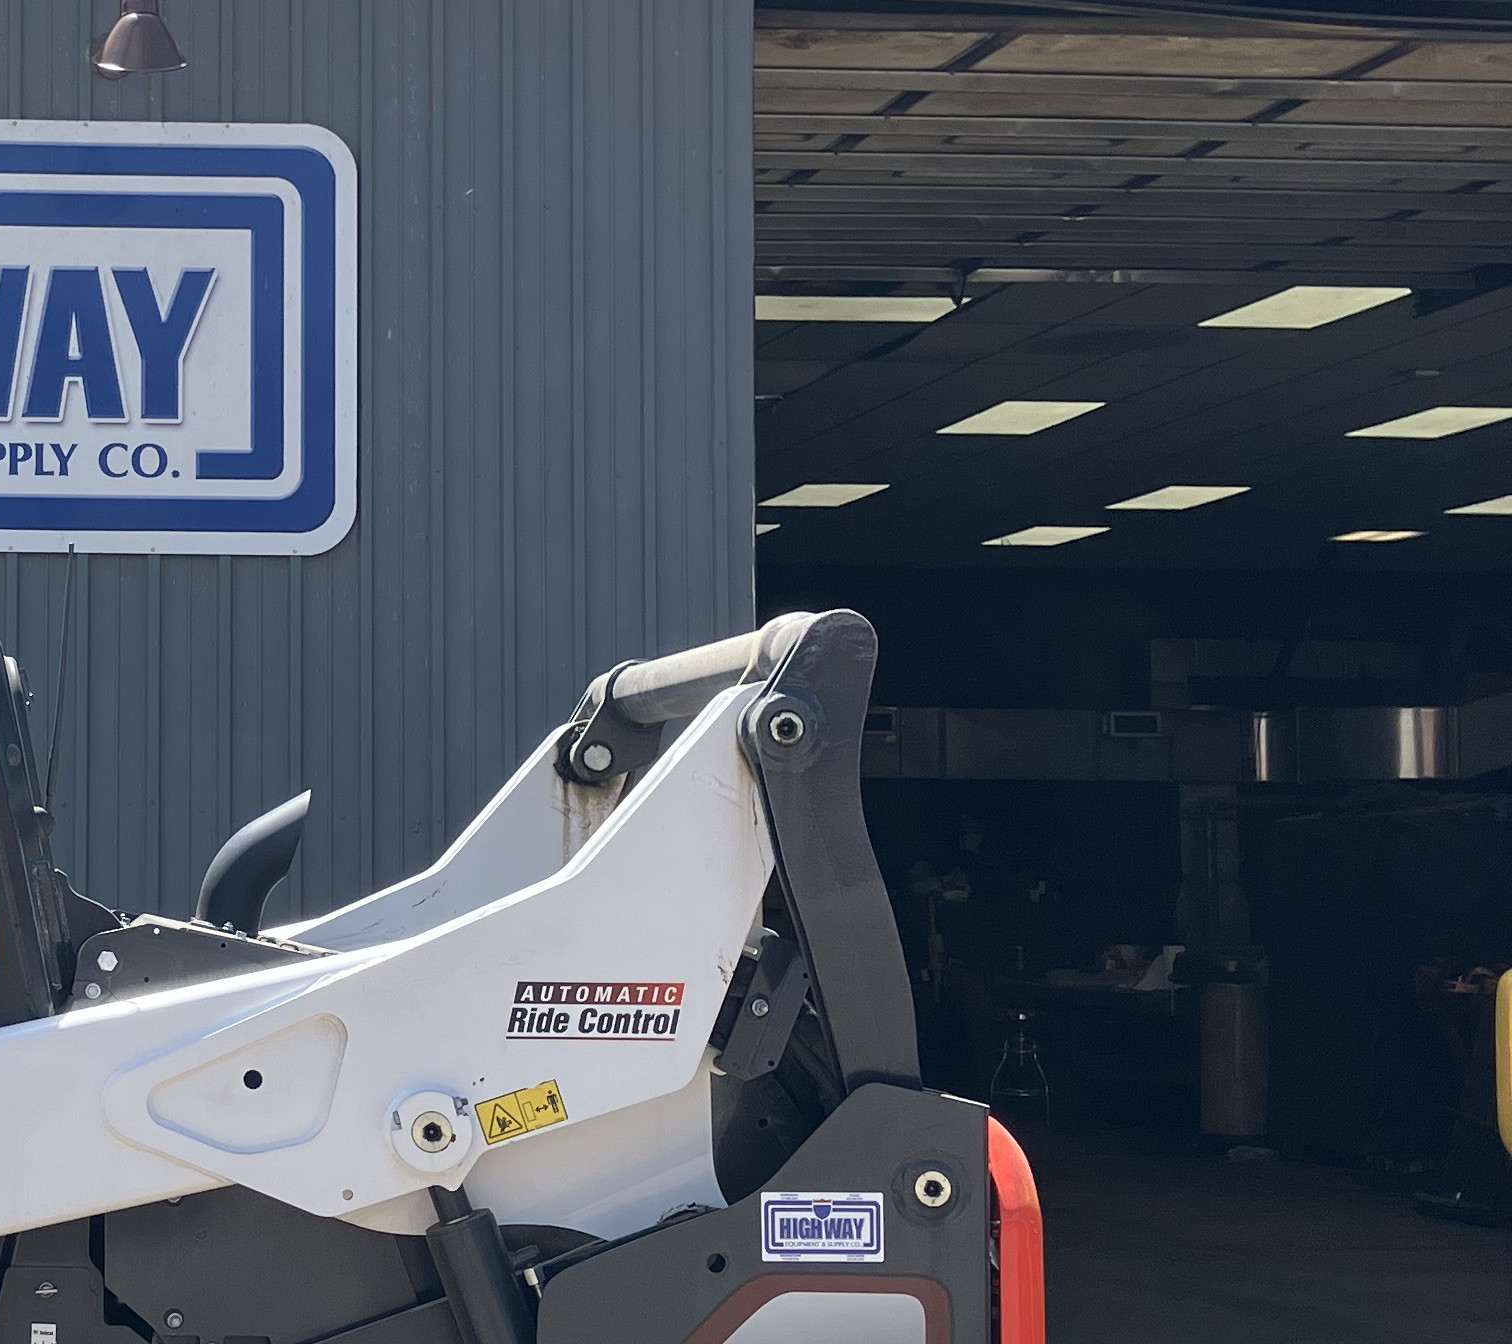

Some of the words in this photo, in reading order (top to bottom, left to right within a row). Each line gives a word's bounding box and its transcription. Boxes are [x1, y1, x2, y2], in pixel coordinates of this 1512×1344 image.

[98, 442, 181, 479] CO.
[520, 985, 678, 1003] AUTOMATIC
[507, 1007, 570, 1033] Ride
[578, 1008, 681, 1035] Control
[779, 1218, 864, 1239] HIGHWAY
